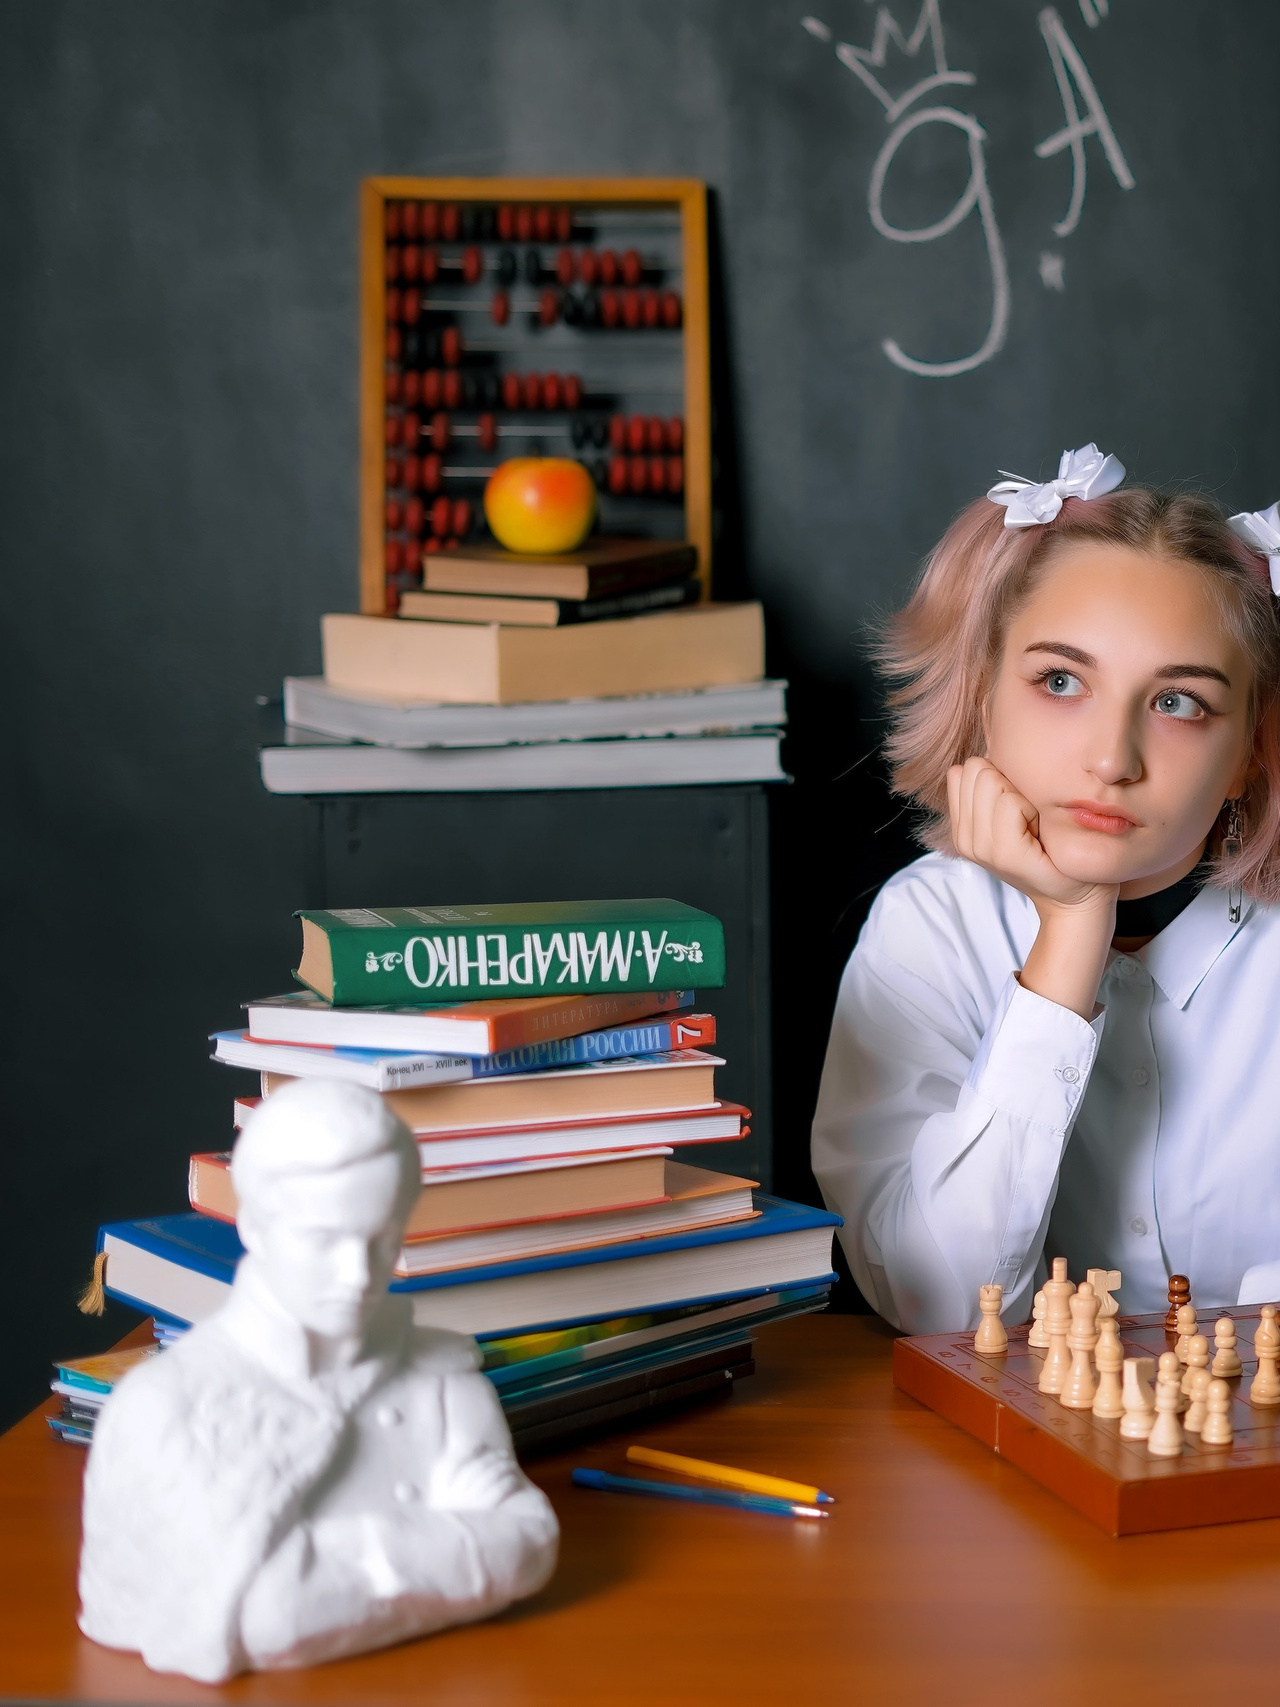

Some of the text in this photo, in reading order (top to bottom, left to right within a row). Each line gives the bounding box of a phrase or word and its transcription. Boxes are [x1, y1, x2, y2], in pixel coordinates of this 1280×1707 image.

[531, 1001, 619, 1032] ЛИТЕРАТУРА
[582, 1026, 662, 1059] РОССИИ
[676, 1024, 702, 1044] 7
[386, 1065, 411, 1077] Конец
[455, 1057, 469, 1068] век
